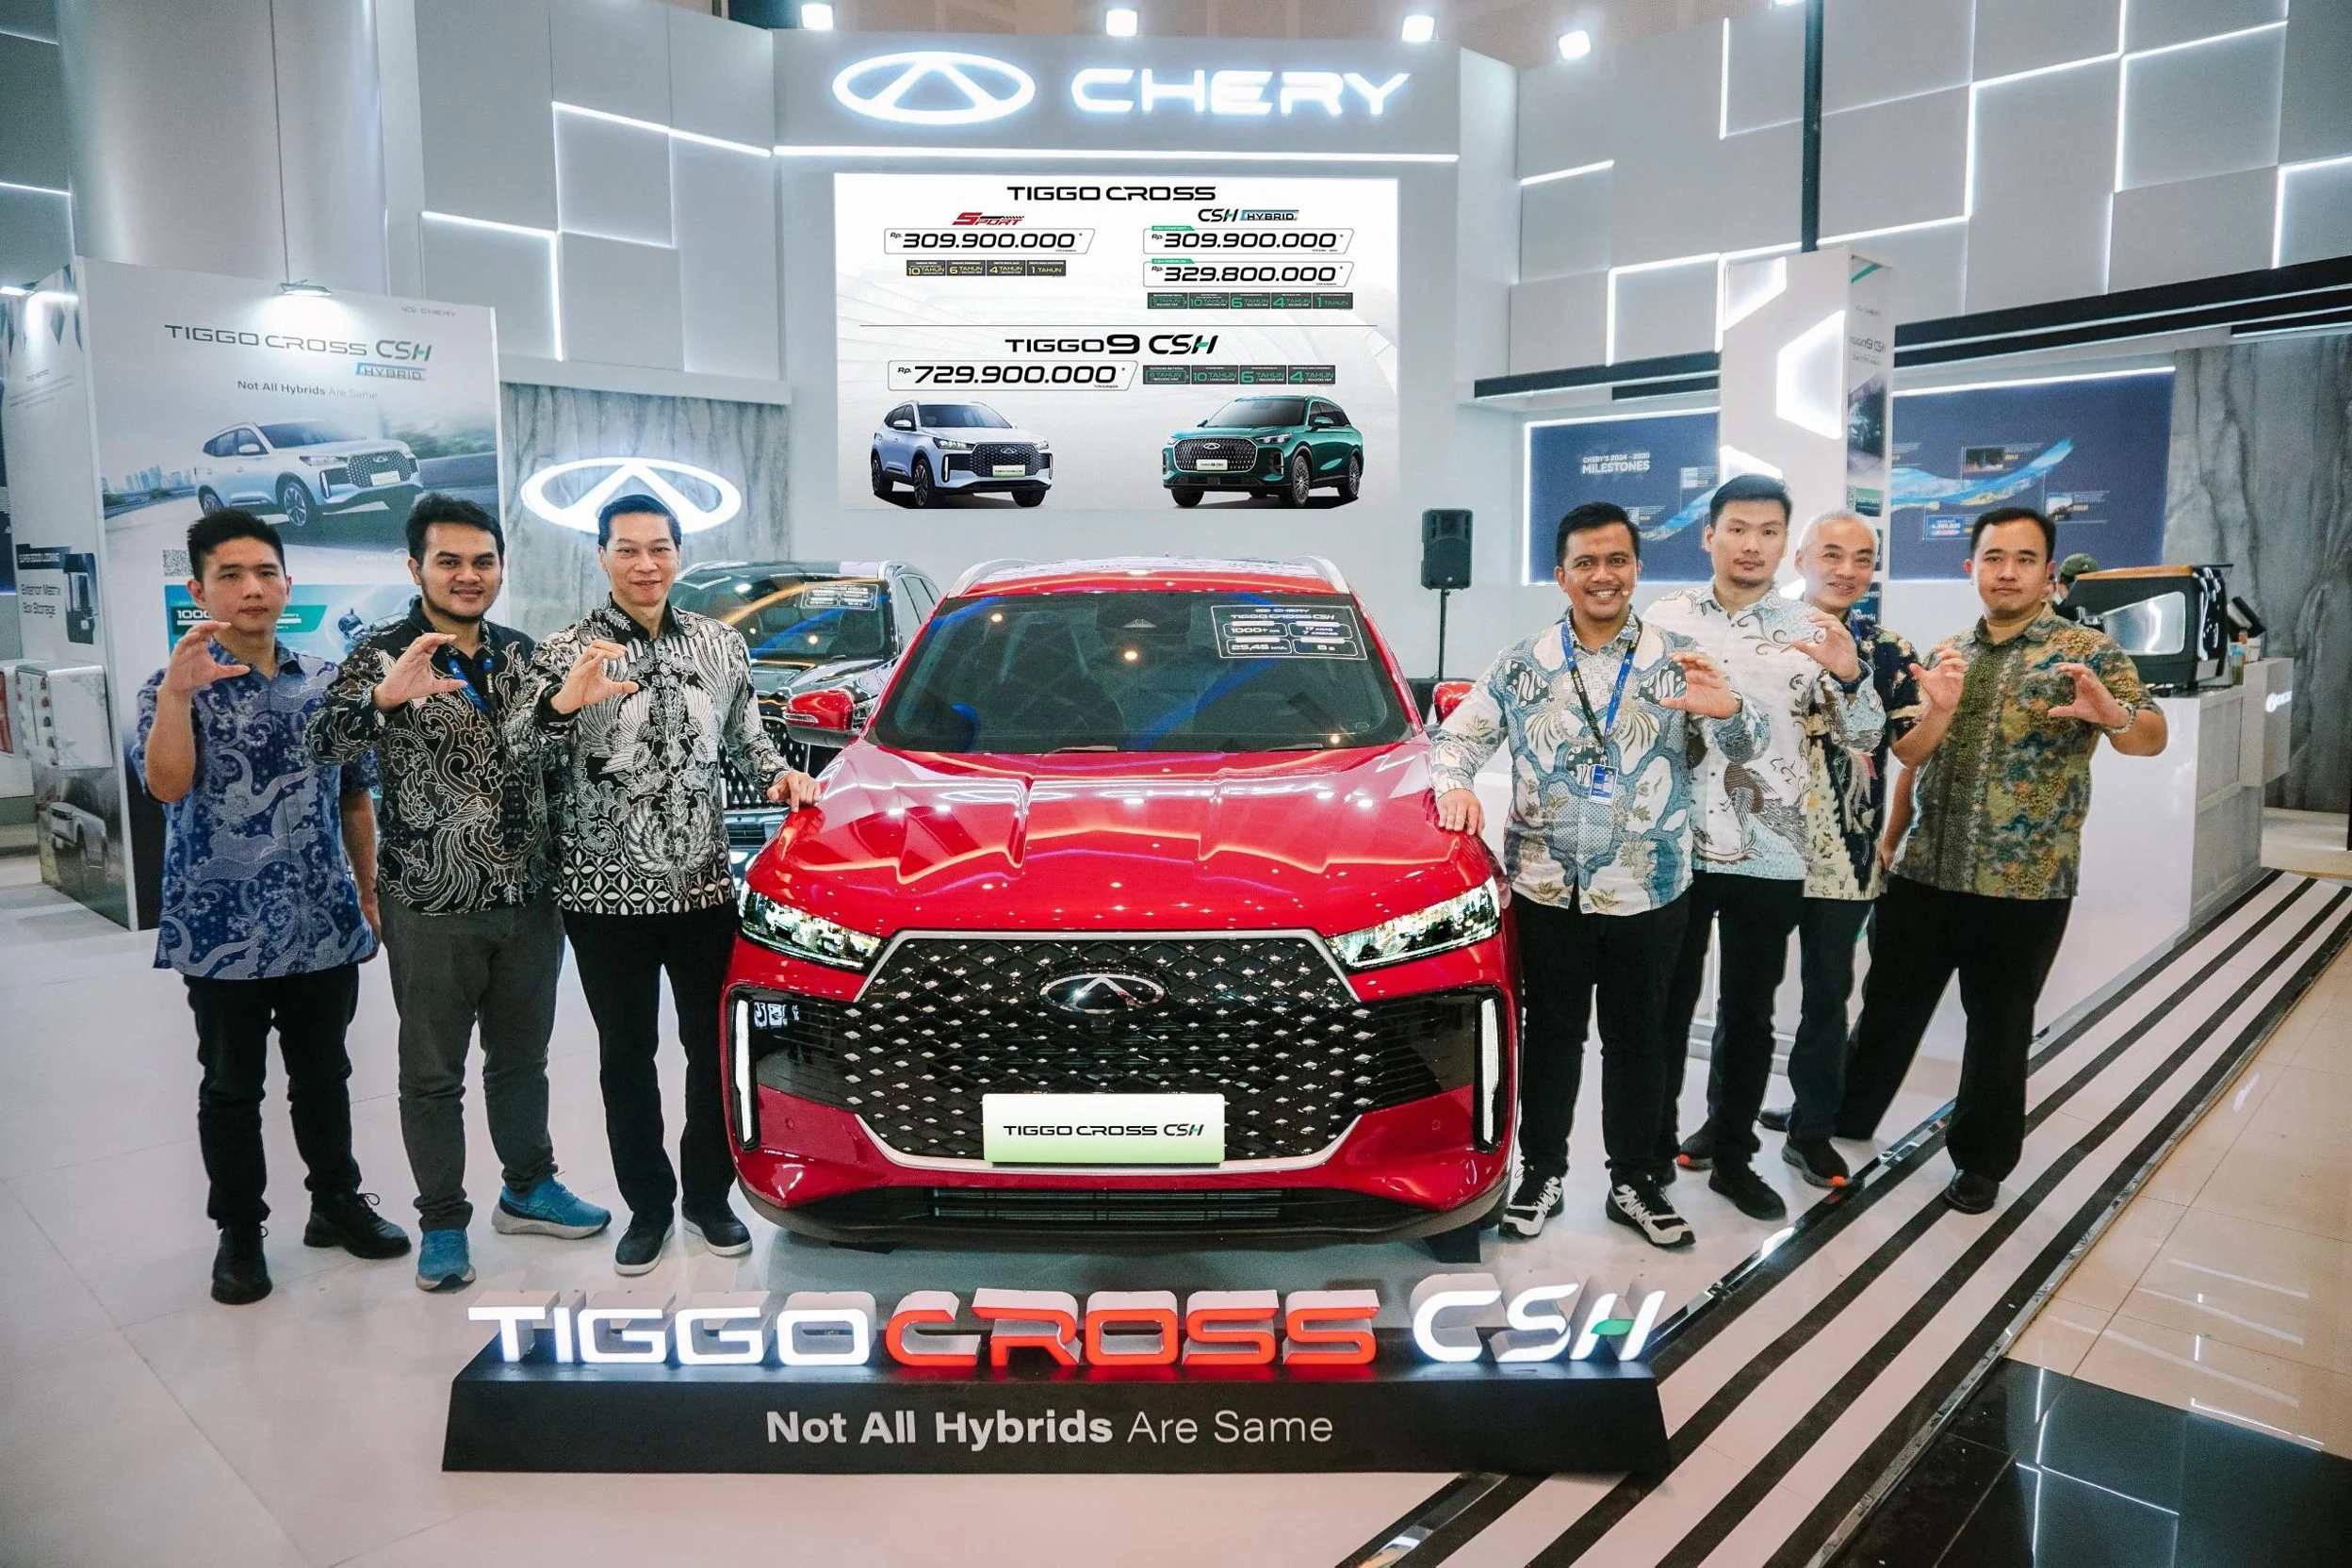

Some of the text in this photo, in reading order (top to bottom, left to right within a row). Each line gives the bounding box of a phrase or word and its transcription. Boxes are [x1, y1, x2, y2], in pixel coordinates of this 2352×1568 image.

[1072, 69, 1411, 115] CHERY
[1007, 187, 1217, 201] TIGGO CROSS
[952, 212, 1023, 225] SPORT
[1198, 208, 1295, 222] CSH HYBRID
[903, 233, 1075, 248] 309.900.000
[1164, 233, 1336, 248] 309.900.000
[908, 267, 921, 275] 10
[950, 266, 958, 274] 6
[989, 266, 998, 274] 4
[1031, 266, 1036, 274] 1
[1164, 267, 1336, 282] 329.800.000
[1190, 299, 1202, 307] 10
[1231, 297, 1243, 308] 6
[1273, 297, 1285, 308] 4
[1316, 297, 1322, 308] 1
[164, 324, 433, 362] TIGGO CROSS CSH
[1149, 334, 1218, 355] CSH
[363, 366, 422, 381] HYBRID
[914, 366, 1117, 384] 729.900.000
[1193, 372, 1207, 382] 10
[1241, 370, 1254, 384] 6
[1289, 370, 1304, 384] 4
[237, 380, 377, 400] Not All Hybrids Are Same
[1582, 460, 1651, 475] MILESTONES
[1003, 1123, 1204, 1136] TIGGO CROSS CSH
[467, 1282, 1666, 1367] TIGGO CROSS CSH
[767, 1410, 1334, 1452] Not All Hybrids Are Same
